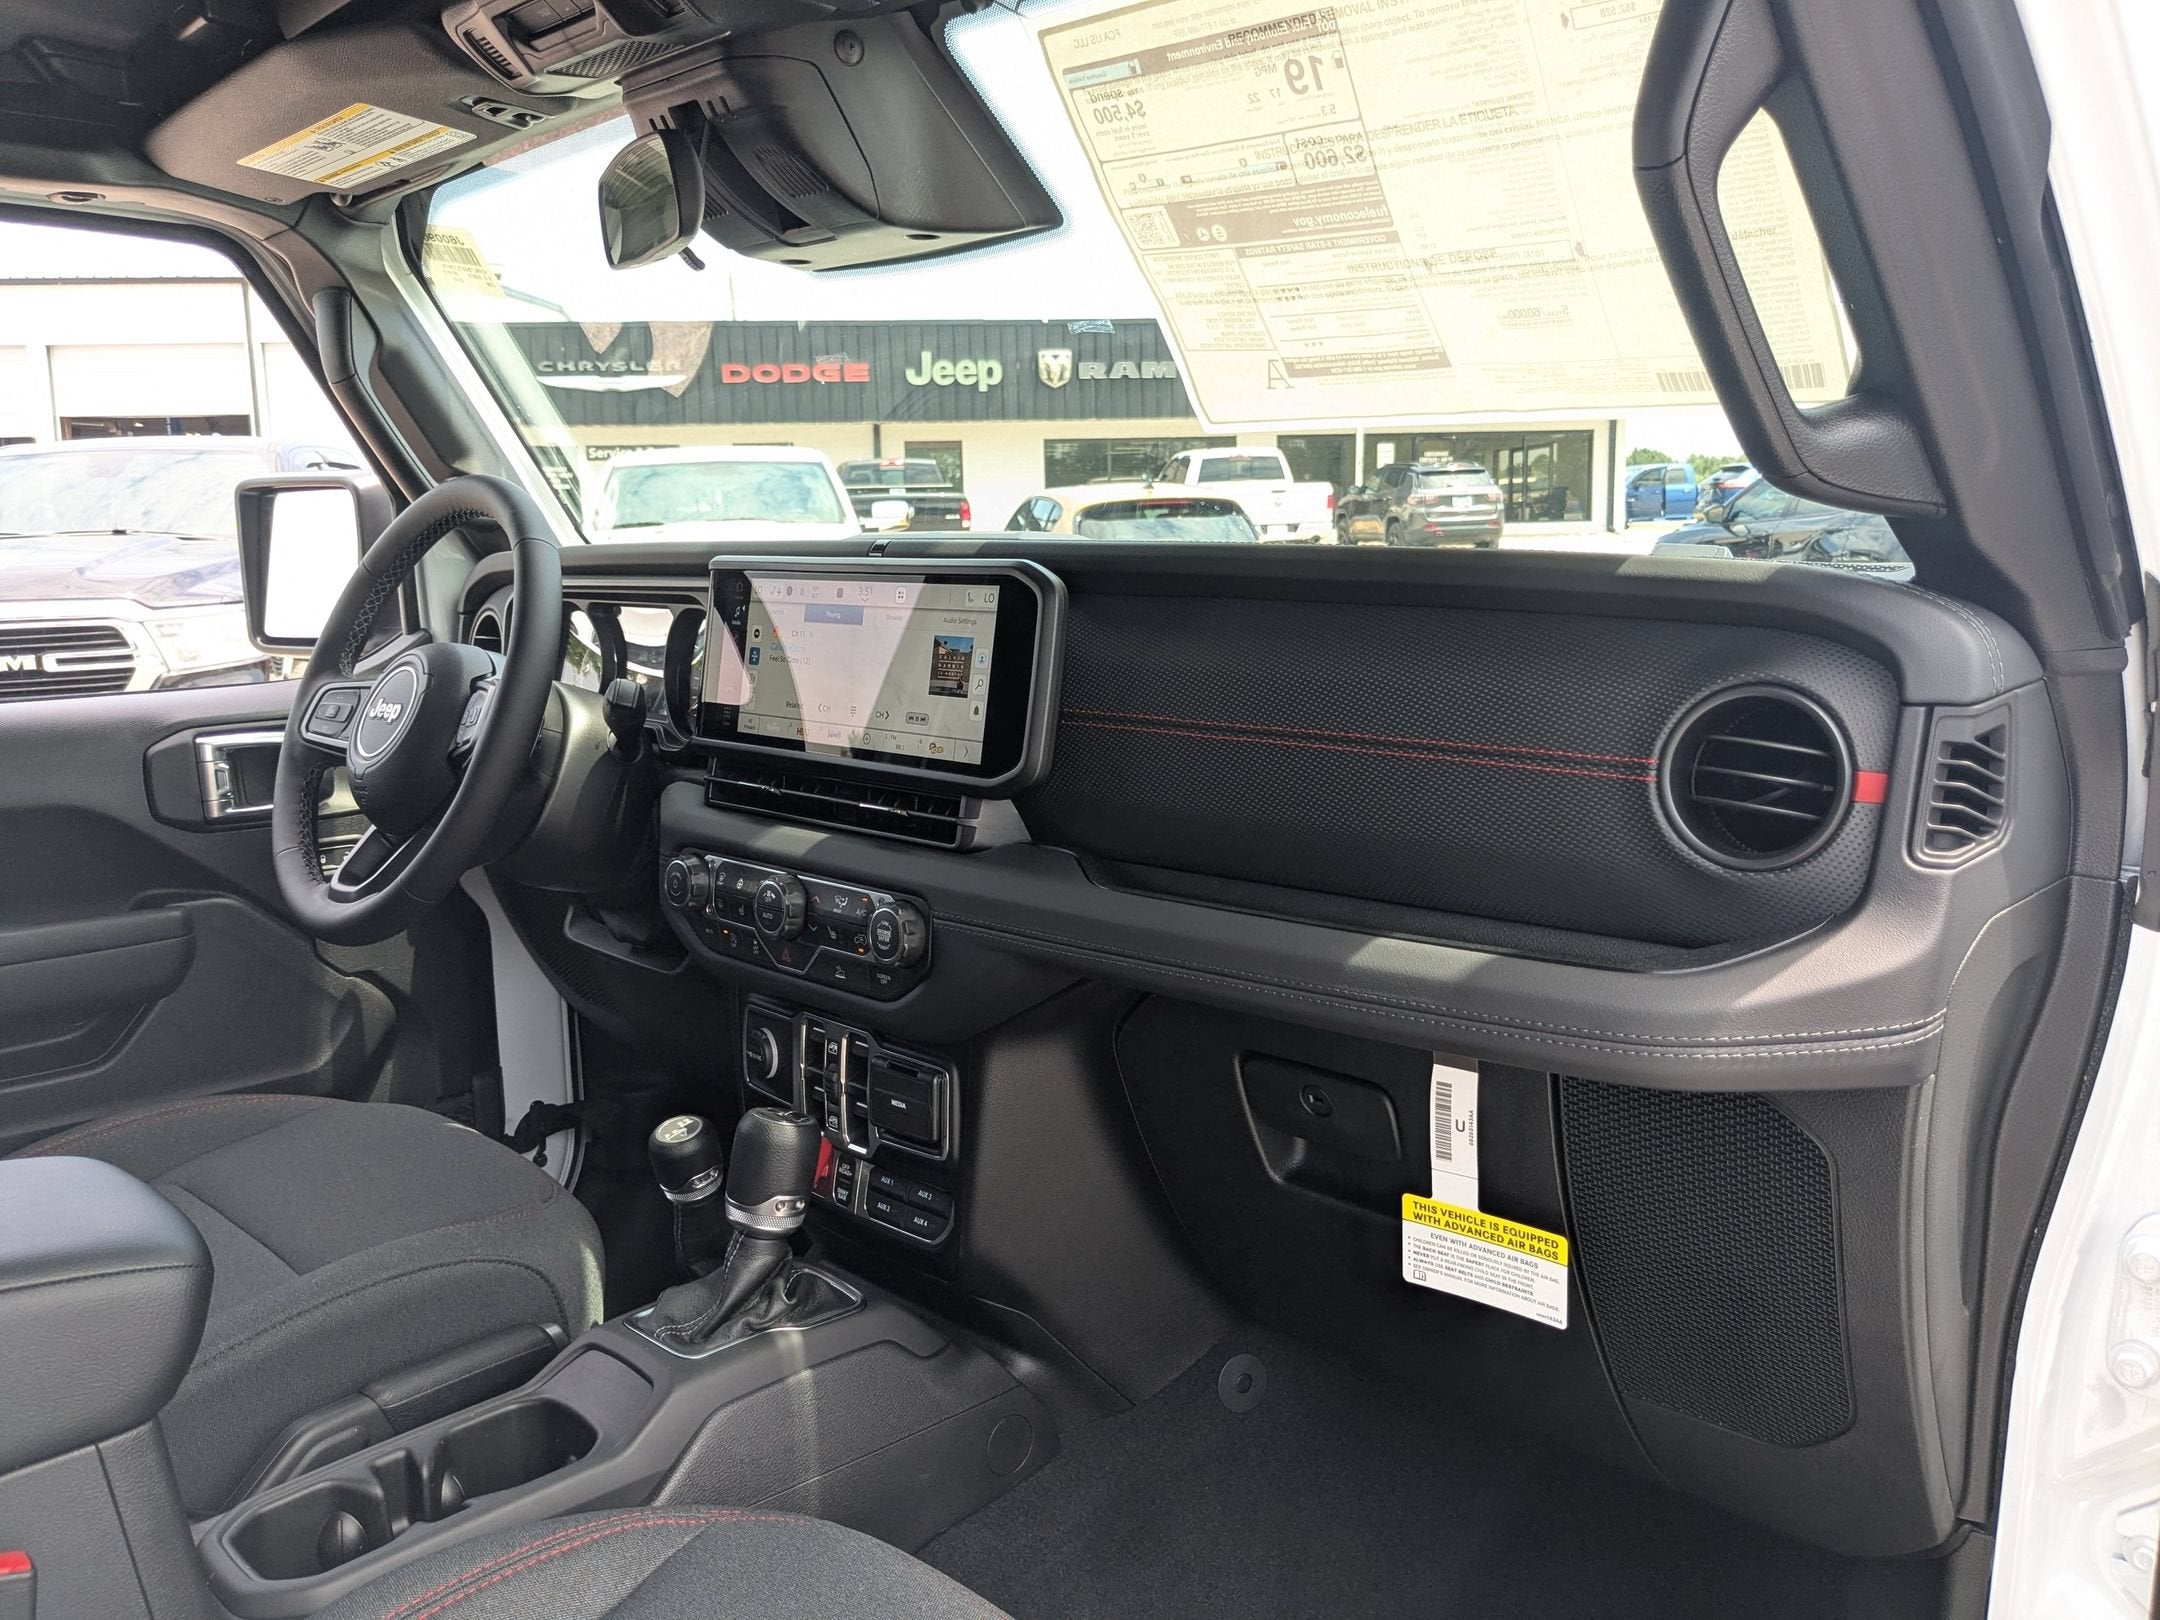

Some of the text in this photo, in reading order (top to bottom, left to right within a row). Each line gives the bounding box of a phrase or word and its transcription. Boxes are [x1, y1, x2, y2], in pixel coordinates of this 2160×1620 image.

[1365, 118, 1443, 141] DESPRENDER
[1441, 115, 1460, 128] LA
[537, 360, 681, 372] CHRYSLER
[905, 351, 1003, 392] Jeep
[1078, 361, 1177, 380] RAM
[721, 363, 870, 384] DODGE
[984, 592, 996, 605] LO
[943, 616, 978, 628] Audio Settings
[369, 697, 402, 723] Jeep
[875, 711, 884, 719] CH
[762, 912, 774, 920] AUTO
[856, 907, 867, 917] A/C
[890, 1099, 907, 1110] MEDIA
[1456, 1118, 1466, 1132] U
[880, 1176, 890, 1186] AUX
[918, 1190, 928, 1200] AUX
[877, 1202, 886, 1212] AUX
[914, 1216, 924, 1226] AUX
[1413, 1200, 1560, 1250] THIS VEHICLE IS EQUIPPED
[1413, 1211, 1560, 1261] WITH ADVANCED AIR BAGS
[1412, 1249, 1430, 1260] NEVER
[1422, 1246, 1436, 1255] BACK
[1438, 1250, 1450, 1259] SEAT
[1466, 1258, 1484, 1269] SAFEST
[1430, 1232, 1538, 1270] EVEN WITH ADVANCED AIR BAGS
[1412, 1256, 1434, 1268] ALWAYS
[1445, 1265, 1458, 1275] SEAT
[1458, 1269, 1474, 1279] BELTS
[1485, 1276, 1502, 1287] CHILD
